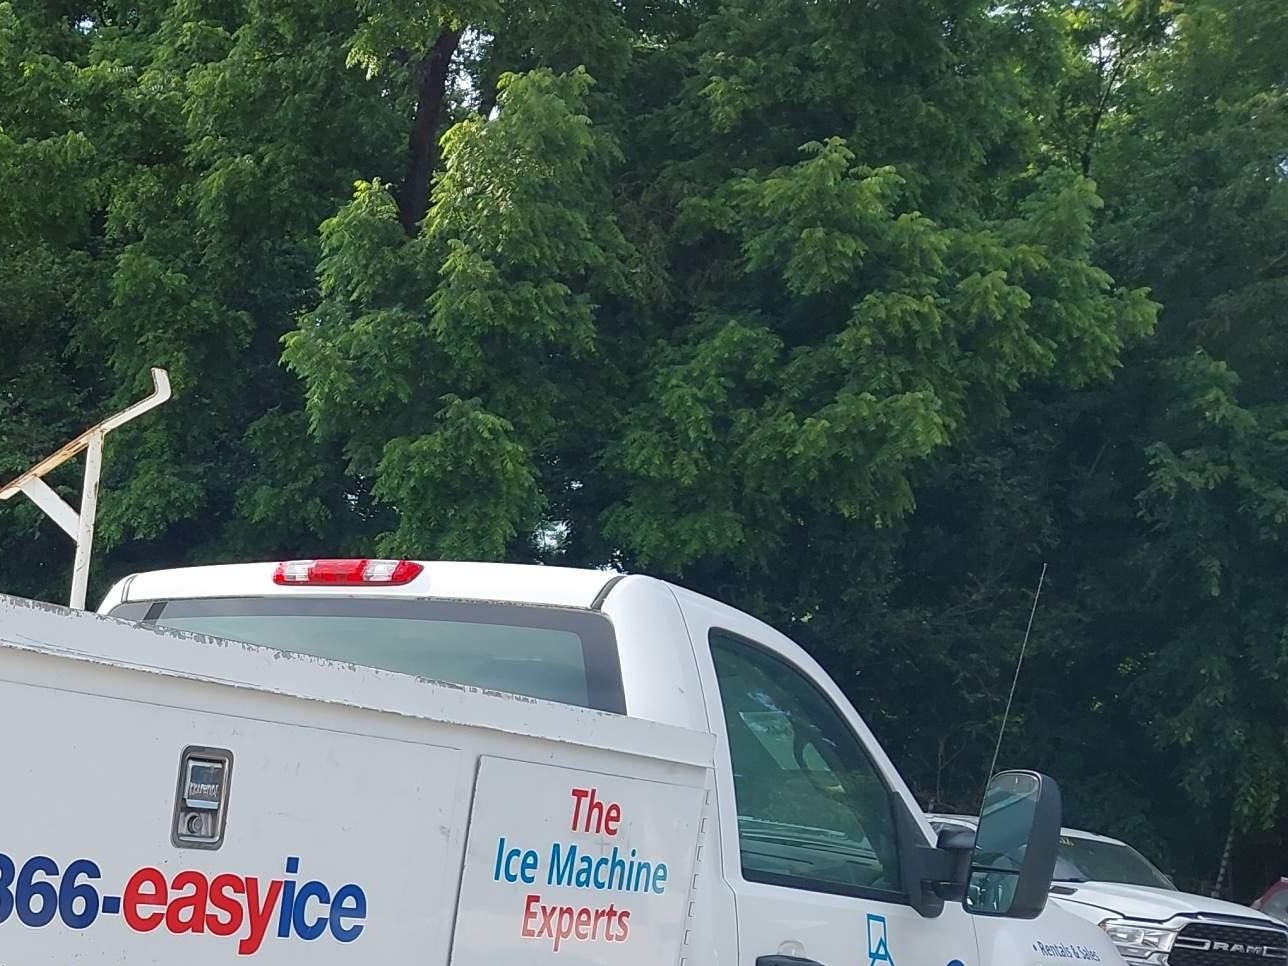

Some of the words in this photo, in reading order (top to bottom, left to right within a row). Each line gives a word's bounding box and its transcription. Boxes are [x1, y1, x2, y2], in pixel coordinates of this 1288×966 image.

[571, 788, 621, 836] The
[494, 838, 536, 884] Ice
[548, 843, 667, 894] Machine
[521, 894, 631, 952] Experts
[1037, 941, 1073, 958] Rentals
[1213, 940, 1266, 956] RAM
